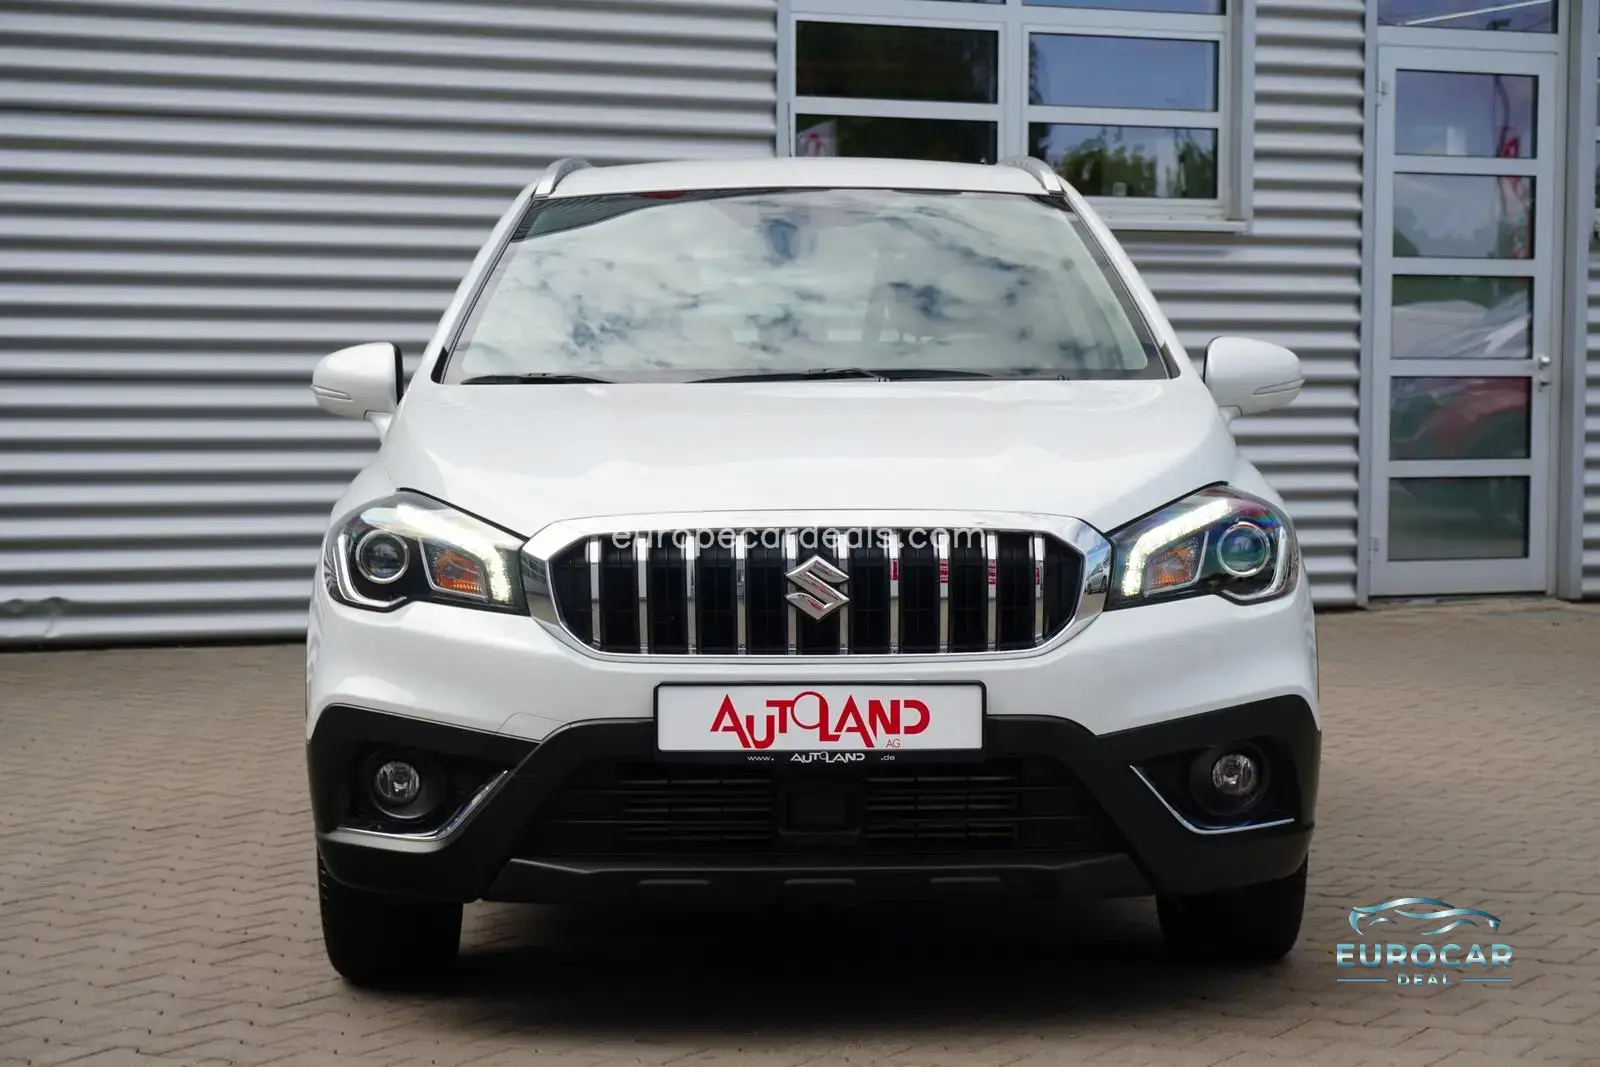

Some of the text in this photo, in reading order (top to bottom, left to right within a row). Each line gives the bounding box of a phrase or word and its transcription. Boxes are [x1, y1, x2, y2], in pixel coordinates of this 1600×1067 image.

[709, 691, 930, 749] AUTOLAND
[886, 738, 901, 749] AG
[790, 751, 865, 763] AUTOLAND
